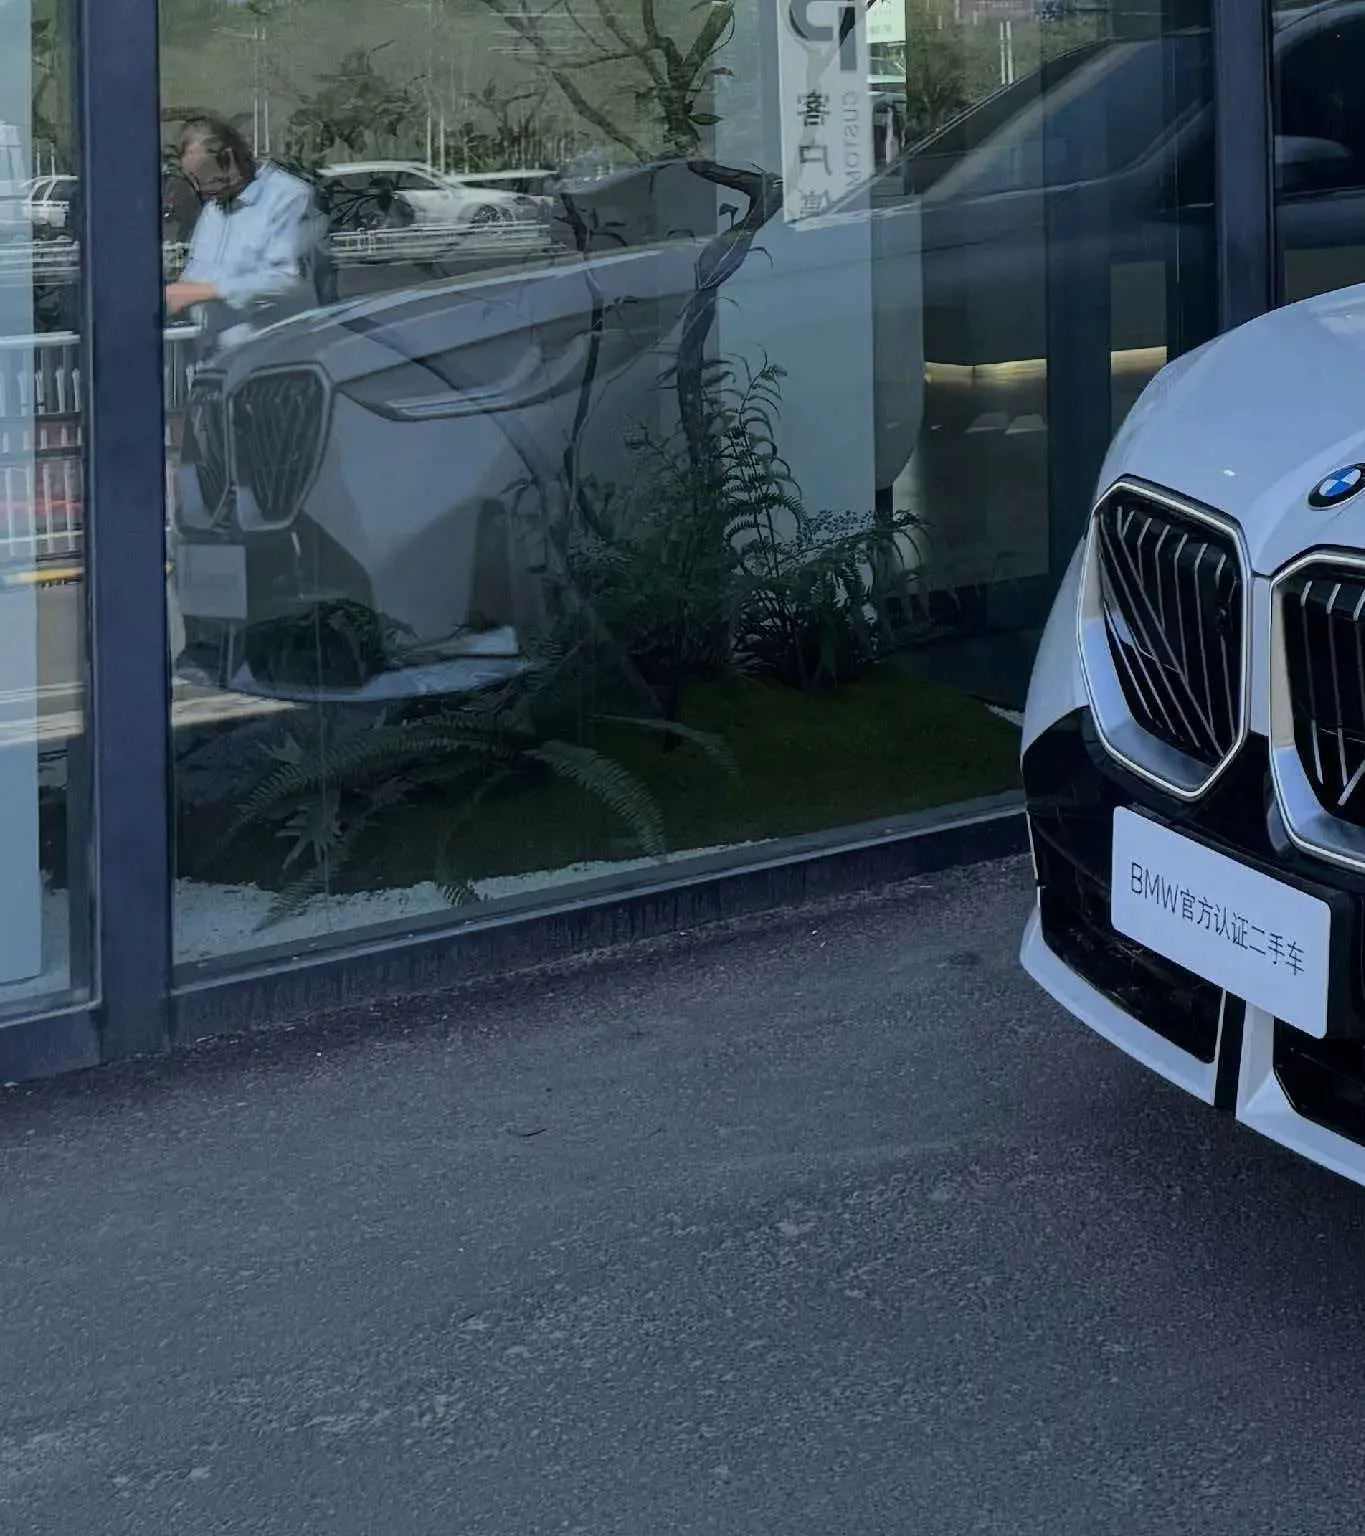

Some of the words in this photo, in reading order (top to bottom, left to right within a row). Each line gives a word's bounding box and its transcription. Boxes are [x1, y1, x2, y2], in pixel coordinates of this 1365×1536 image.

[1130, 861, 1305, 977] BMW官方认证二手车
